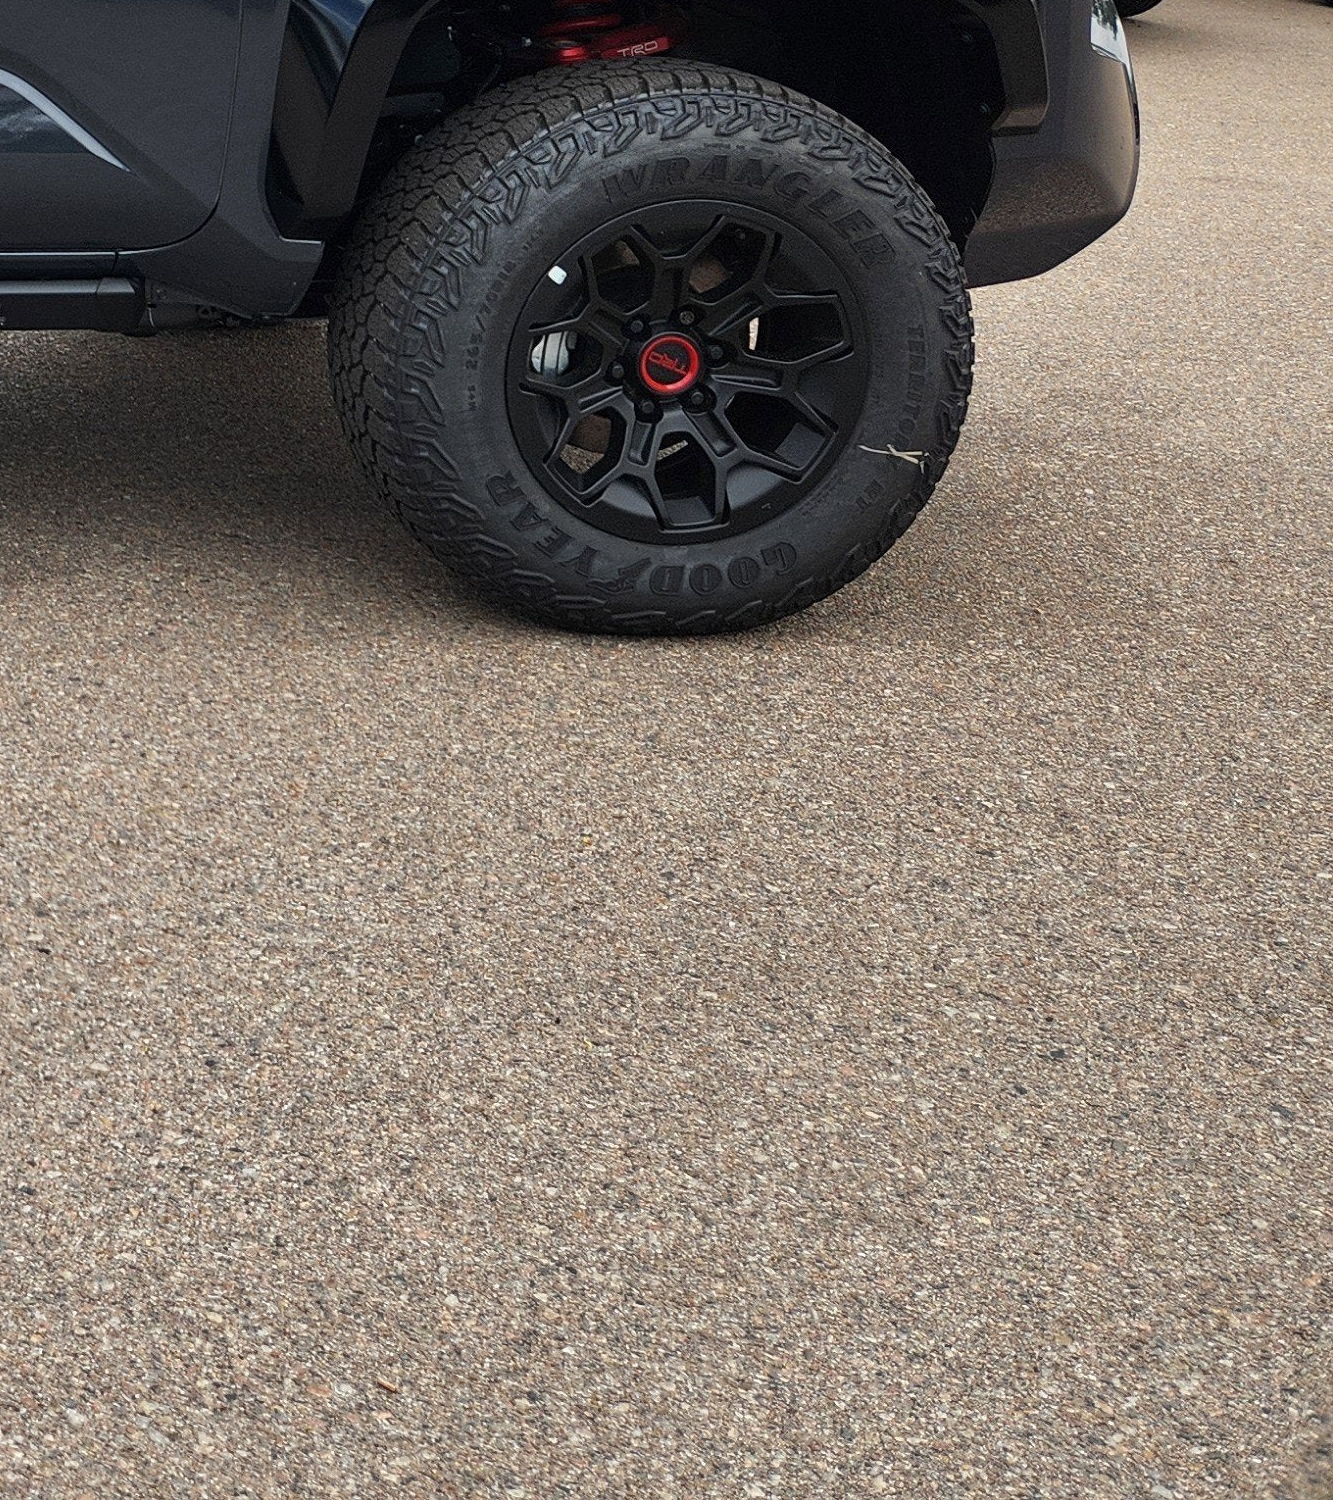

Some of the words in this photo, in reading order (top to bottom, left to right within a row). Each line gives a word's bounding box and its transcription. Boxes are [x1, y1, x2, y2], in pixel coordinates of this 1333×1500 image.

[616, 40, 659, 57] TRD
[600, 153, 898, 270] WRANGLER
[649, 351, 688, 376] TRD
[485, 469, 798, 596] GOODYEAR
